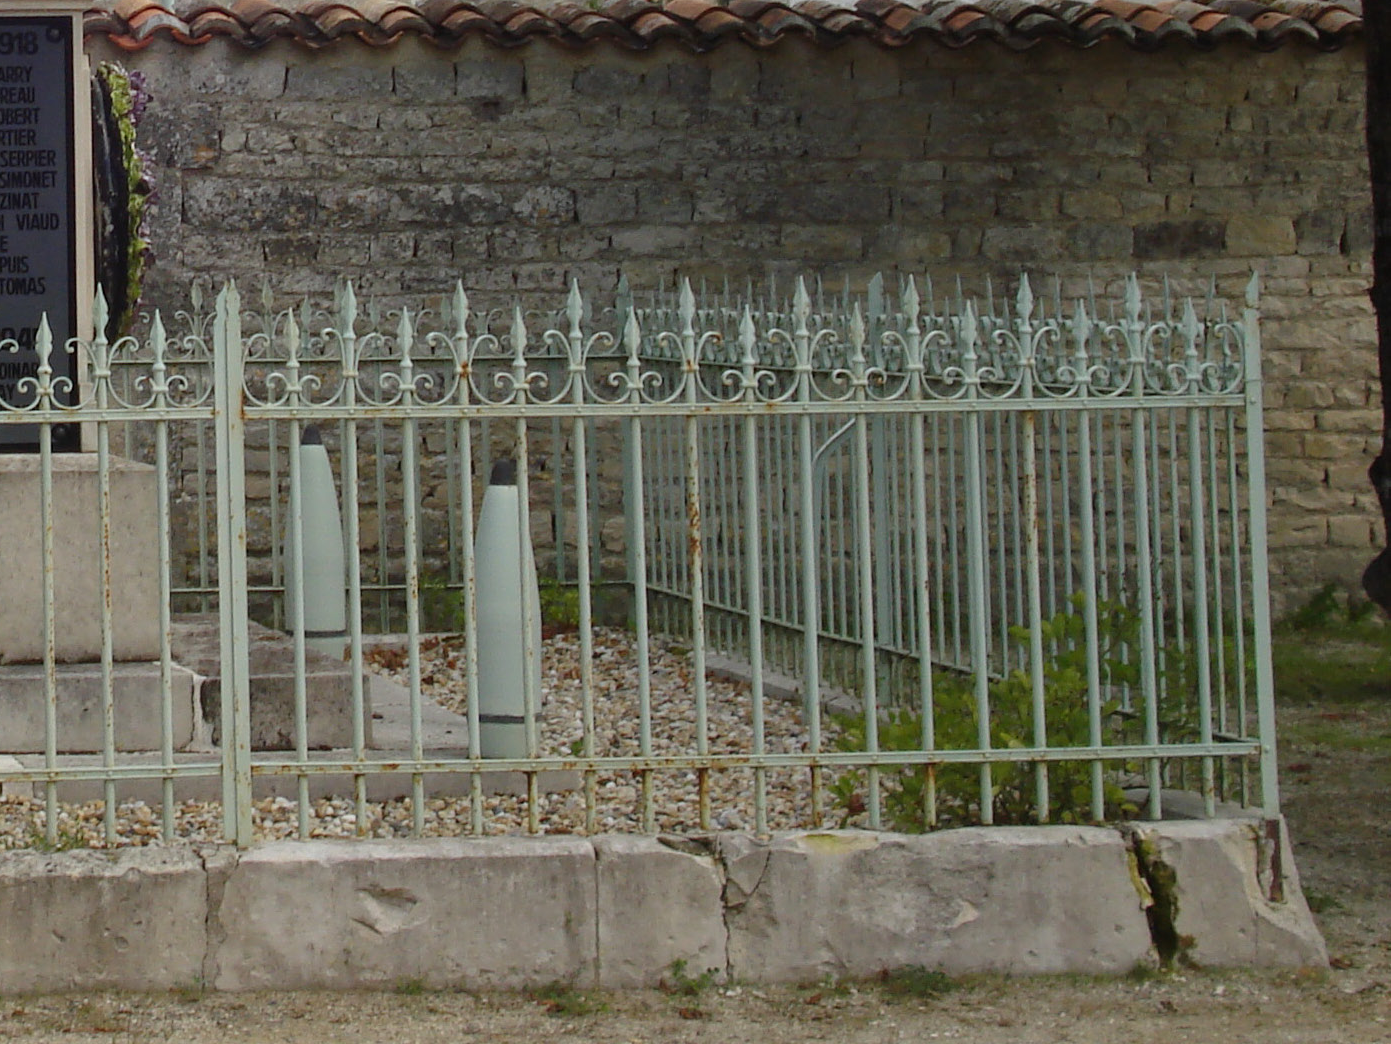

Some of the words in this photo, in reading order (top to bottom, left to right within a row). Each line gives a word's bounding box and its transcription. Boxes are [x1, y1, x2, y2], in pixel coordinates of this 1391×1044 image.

[0, 150, 56, 168] SERPIER
[0, 171, 58, 188] SIMONET
[16, 213, 59, 231] VIAUD
